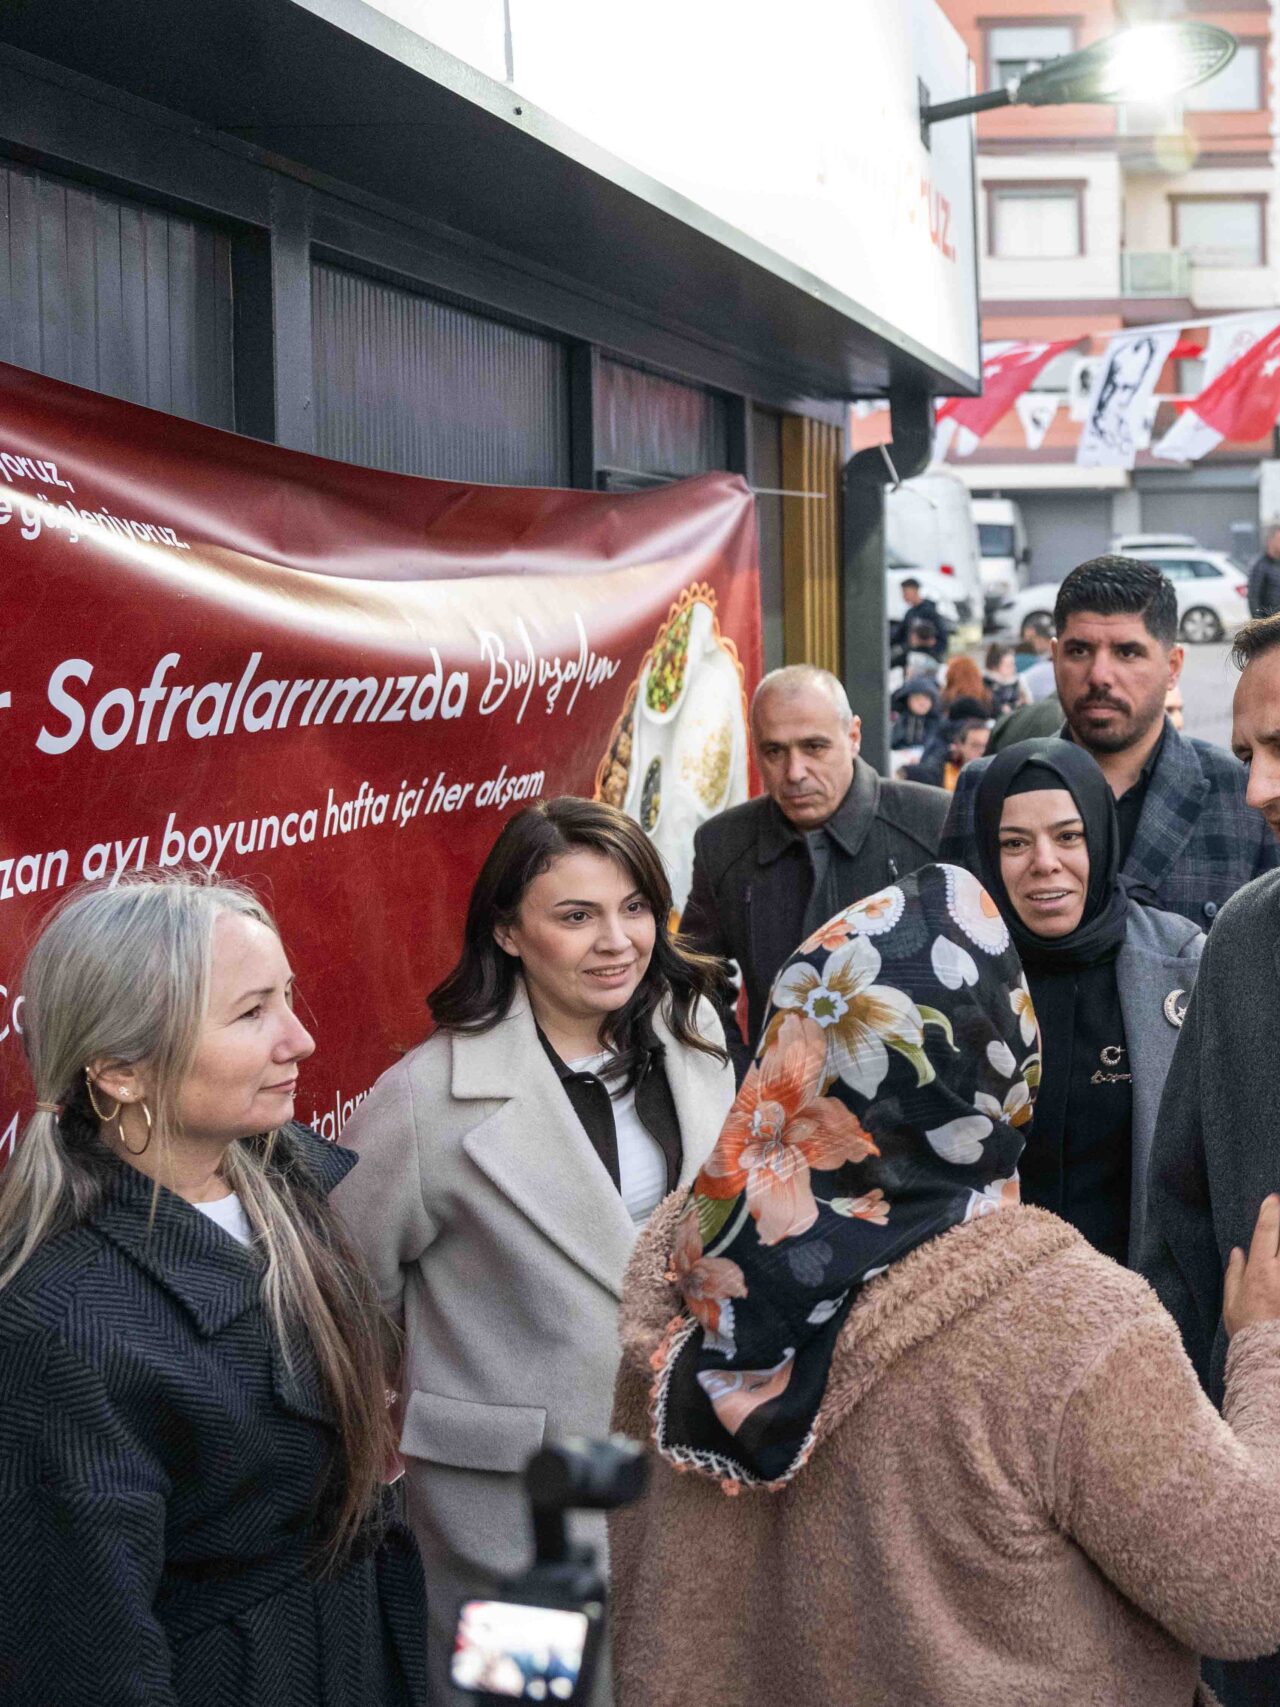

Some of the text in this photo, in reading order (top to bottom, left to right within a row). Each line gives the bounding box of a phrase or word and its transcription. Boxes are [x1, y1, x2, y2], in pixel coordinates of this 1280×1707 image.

[35, 611, 621, 755] Sofralarımızda Buluşalım
[82, 836, 149, 889] ayı
[158, 808, 319, 876] boyunca
[323, 781, 390, 838] hafta
[392, 780, 429, 828] içi
[424, 772, 475, 815] her
[475, 764, 546, 811] akşam
